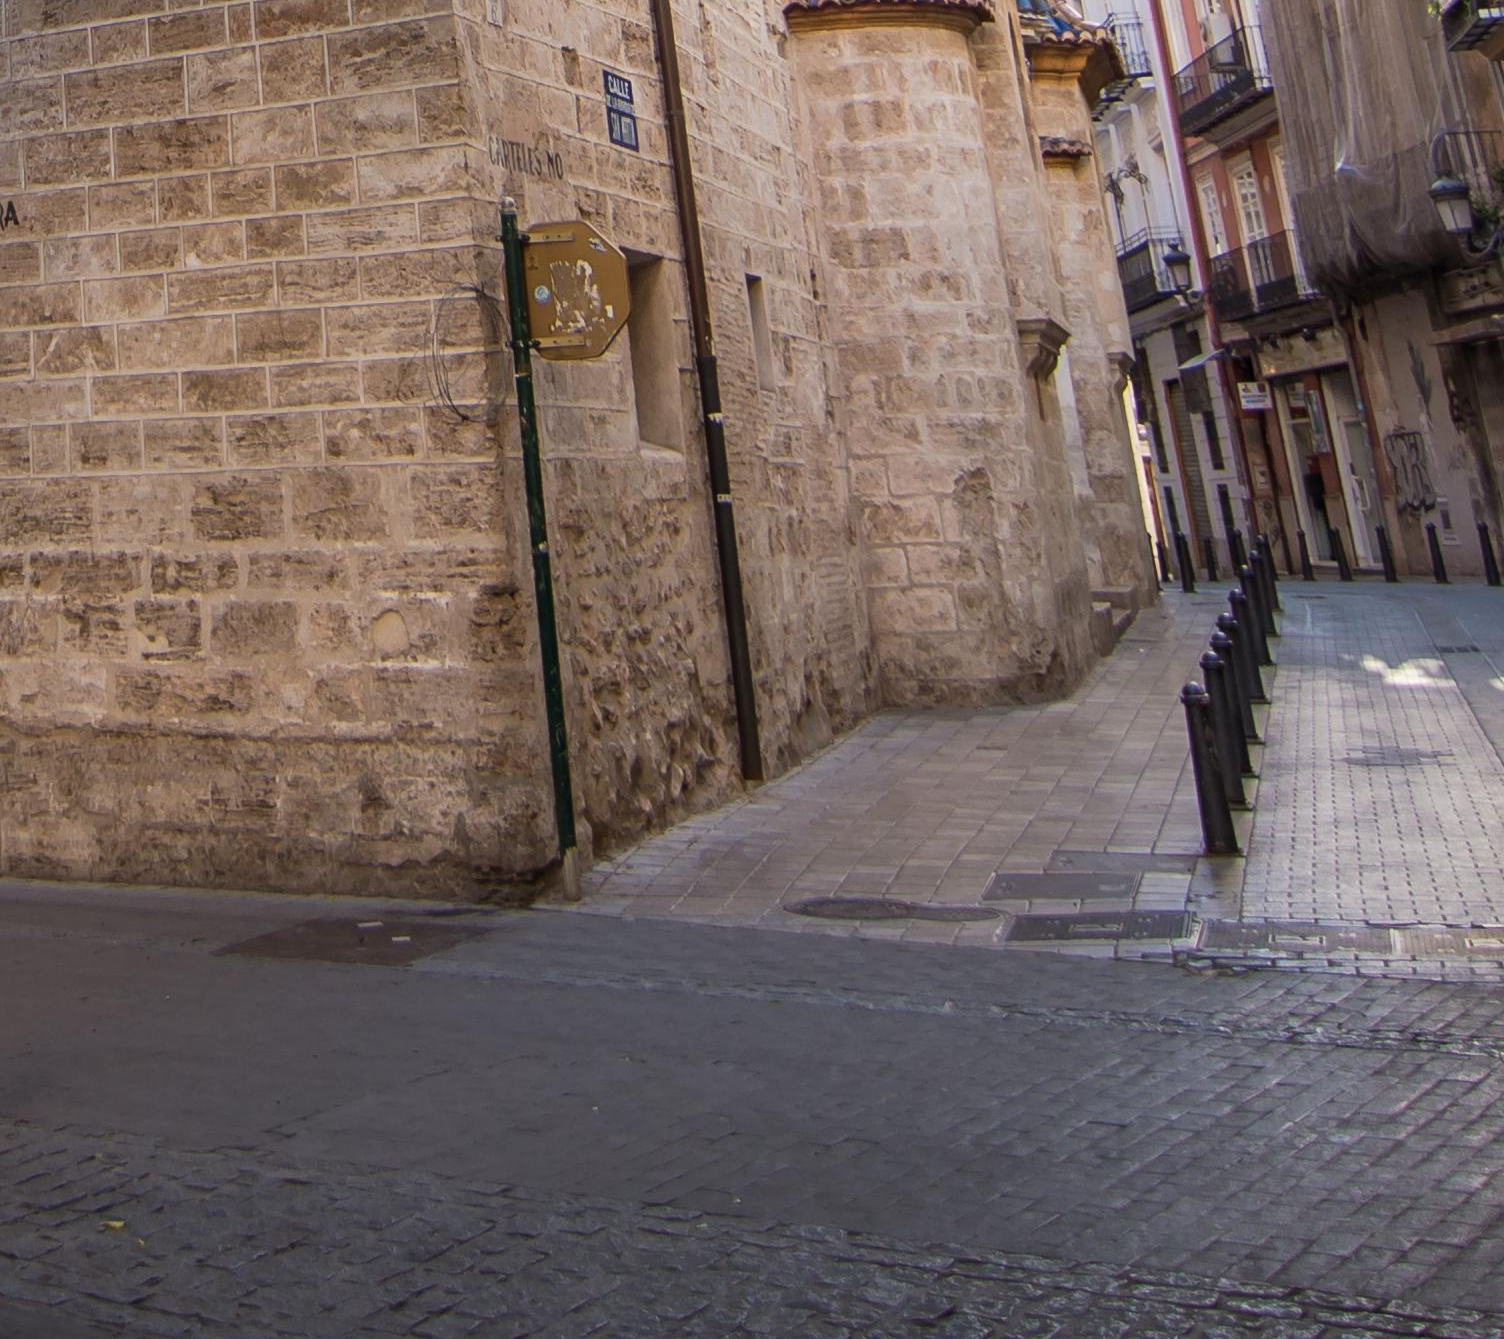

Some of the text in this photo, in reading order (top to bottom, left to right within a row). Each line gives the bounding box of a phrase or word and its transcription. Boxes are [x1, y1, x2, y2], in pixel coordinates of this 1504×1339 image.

[607, 74, 631, 100] CALLE
[488, 135, 564, 180] CARTELES NO
